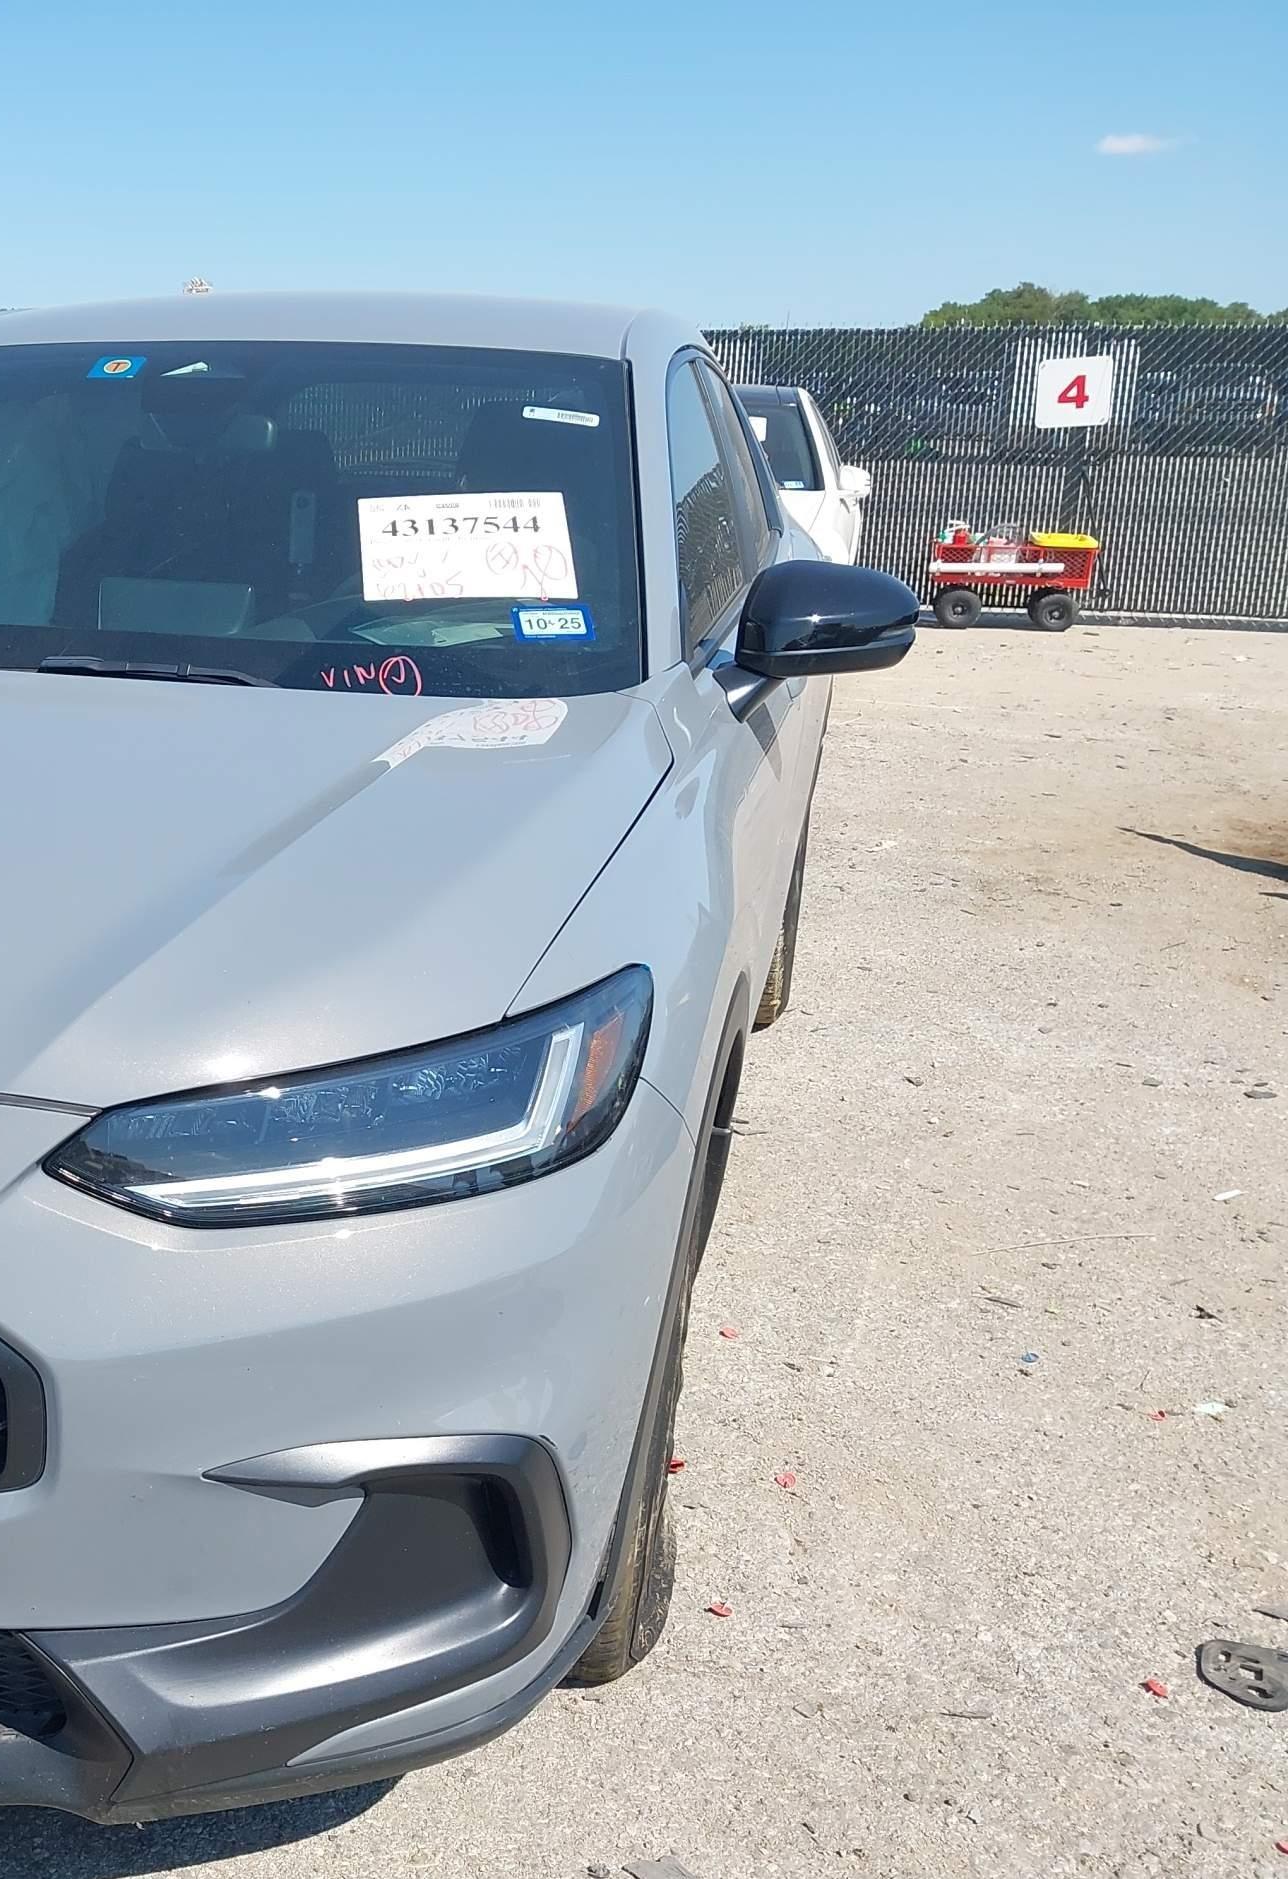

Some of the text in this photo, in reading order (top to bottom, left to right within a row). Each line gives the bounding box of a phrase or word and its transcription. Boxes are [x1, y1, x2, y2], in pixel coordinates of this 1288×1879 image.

[1057, 374, 1089, 408] 4
[382, 515, 541, 536] 43137544
[320, 662, 376, 688] VIN
